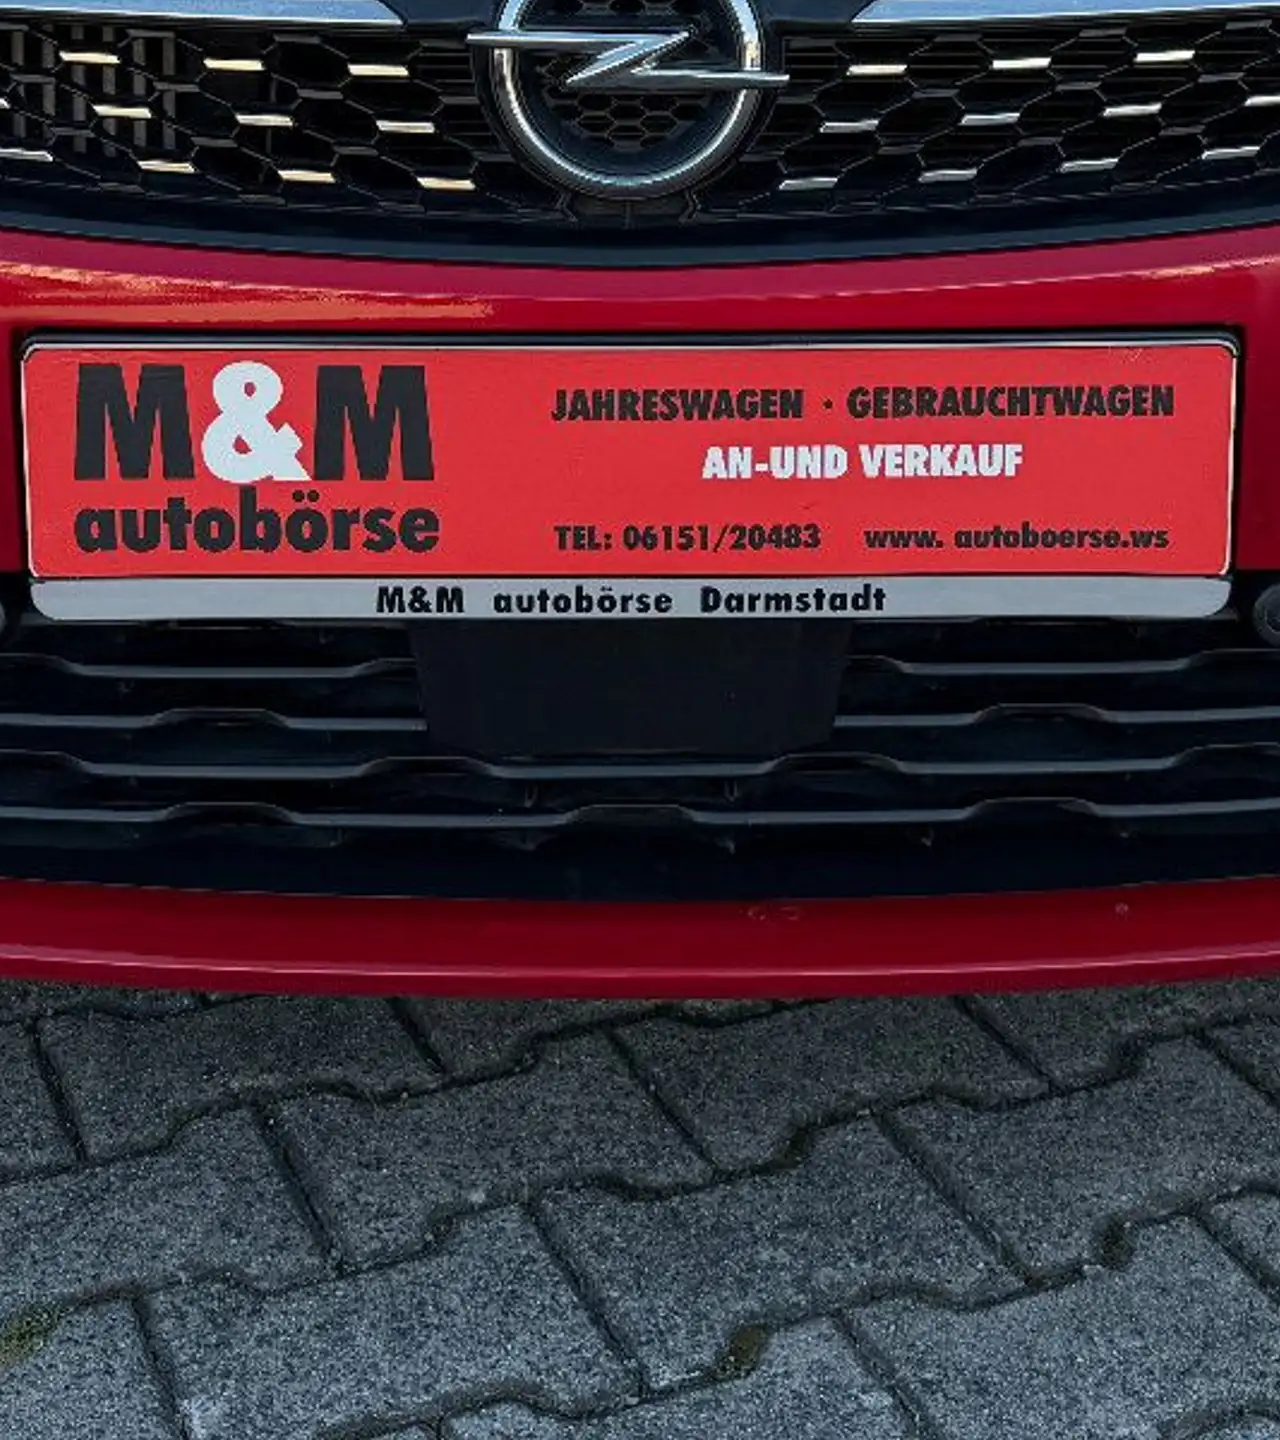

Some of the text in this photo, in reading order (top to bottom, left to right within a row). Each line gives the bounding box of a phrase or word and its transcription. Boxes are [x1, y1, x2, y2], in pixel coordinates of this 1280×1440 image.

[552, 385, 1173, 420] JAHRESWAGEN GEBRAUCHTWAGEN
[75, 361, 434, 482] M&M
[703, 444, 1022, 478] AN-UND VERKAUF
[75, 485, 439, 553] autobörse
[955, 522, 1168, 548] autoboerse.ws
[555, 524, 820, 552] TEL: 06151/20483
[376, 583, 886, 613] M&M autobörse Darmstadt
